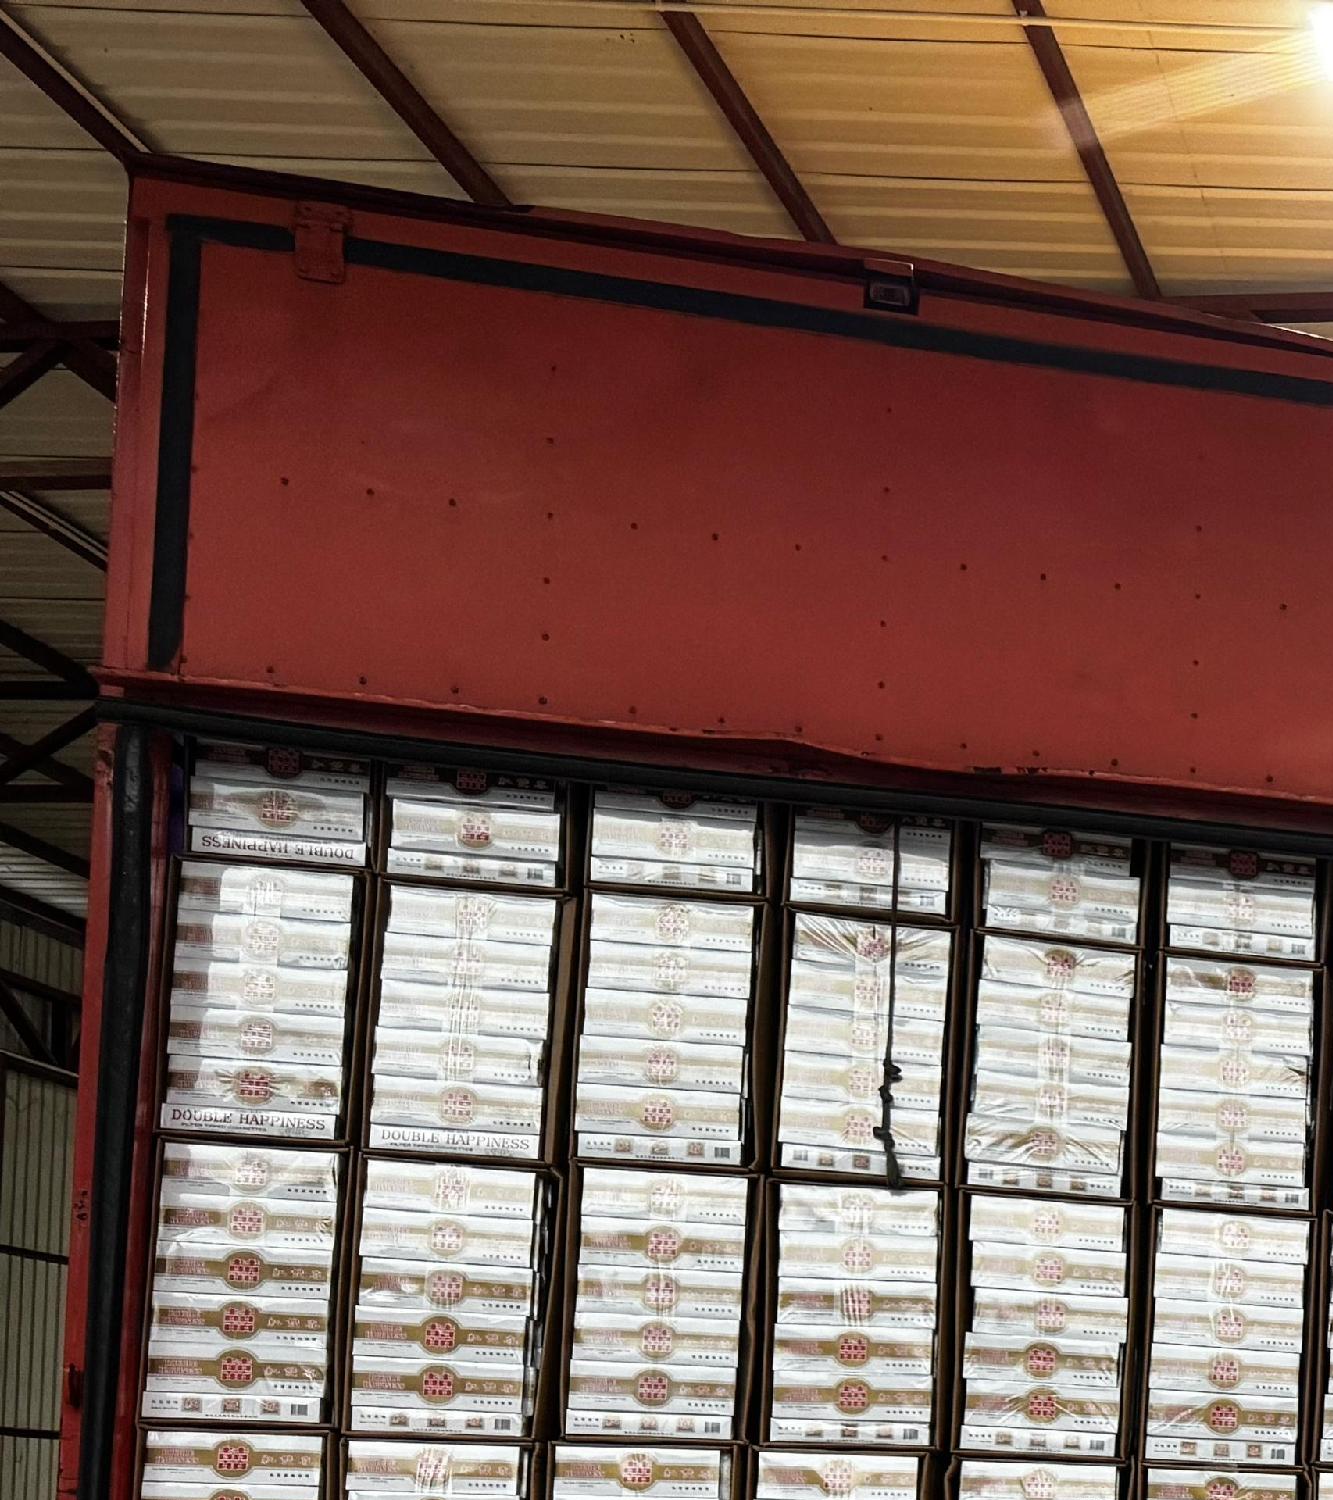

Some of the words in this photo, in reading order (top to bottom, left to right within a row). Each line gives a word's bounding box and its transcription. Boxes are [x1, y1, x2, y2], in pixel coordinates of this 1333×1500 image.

[201, 835, 289, 854] HAPPINESS
[295, 844, 354, 860] DOUBLE
[171, 1108, 232, 1124] DOUBLE
[239, 1113, 326, 1131] HAPPINESS
[381, 1128, 440, 1144] DOUBLE
[446, 1133, 530, 1151] HAPPINESS
